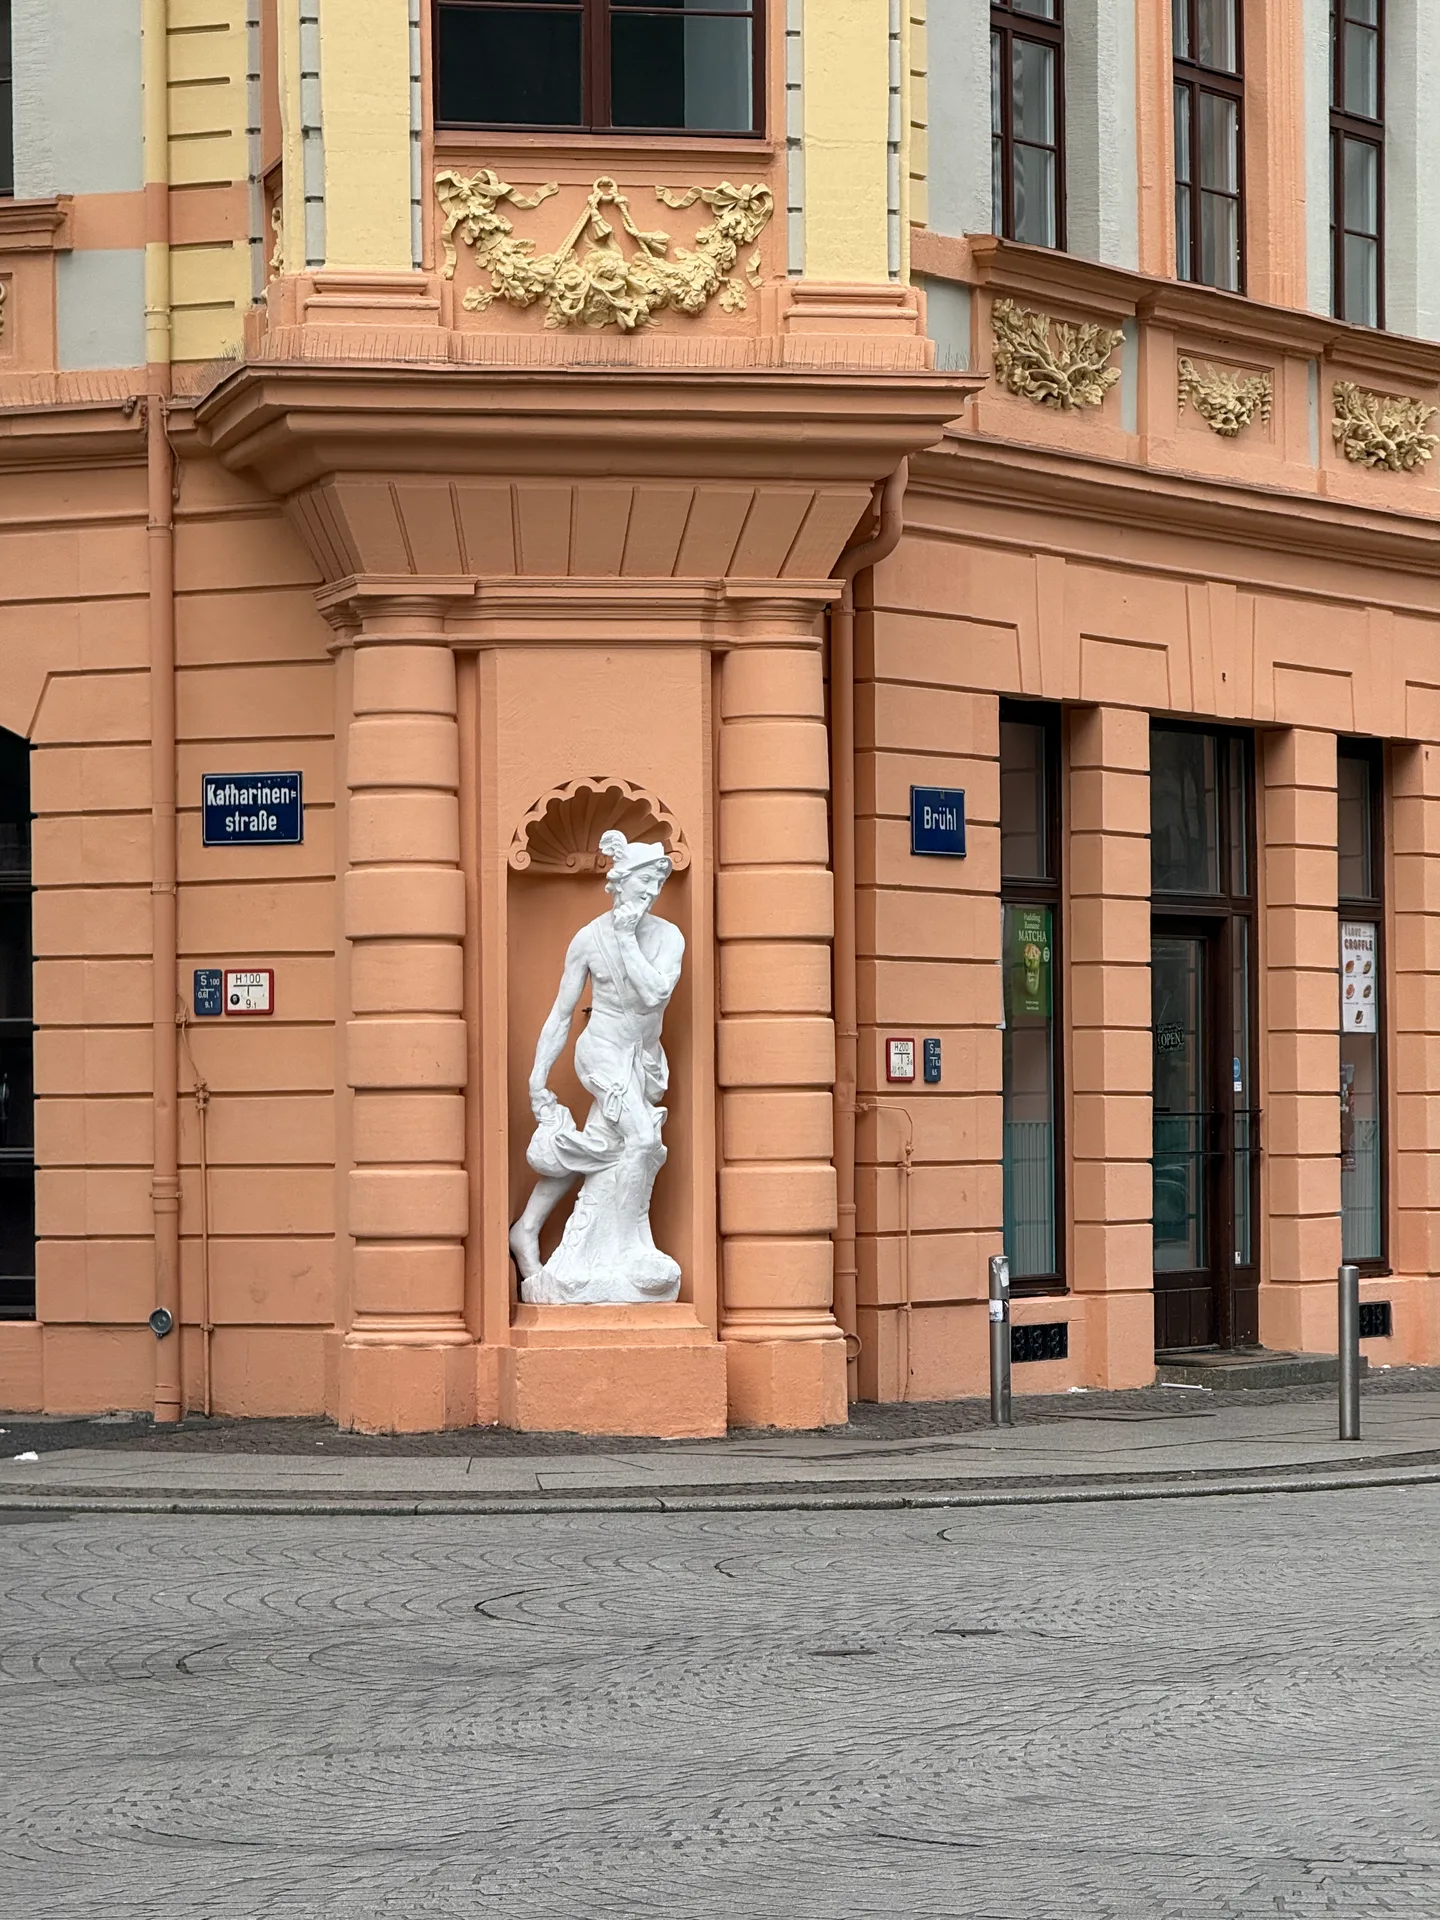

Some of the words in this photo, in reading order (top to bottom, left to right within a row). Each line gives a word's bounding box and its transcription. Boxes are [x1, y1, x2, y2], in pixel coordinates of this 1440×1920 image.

[225, 809, 277, 832] straße
[923, 805, 957, 831] Brühl
[1018, 930, 1047, 942] MATCHA
[200, 975, 207, 986] S
[1161, 1032, 1180, 1046] OPEN
[930, 1044, 934, 1053] S
